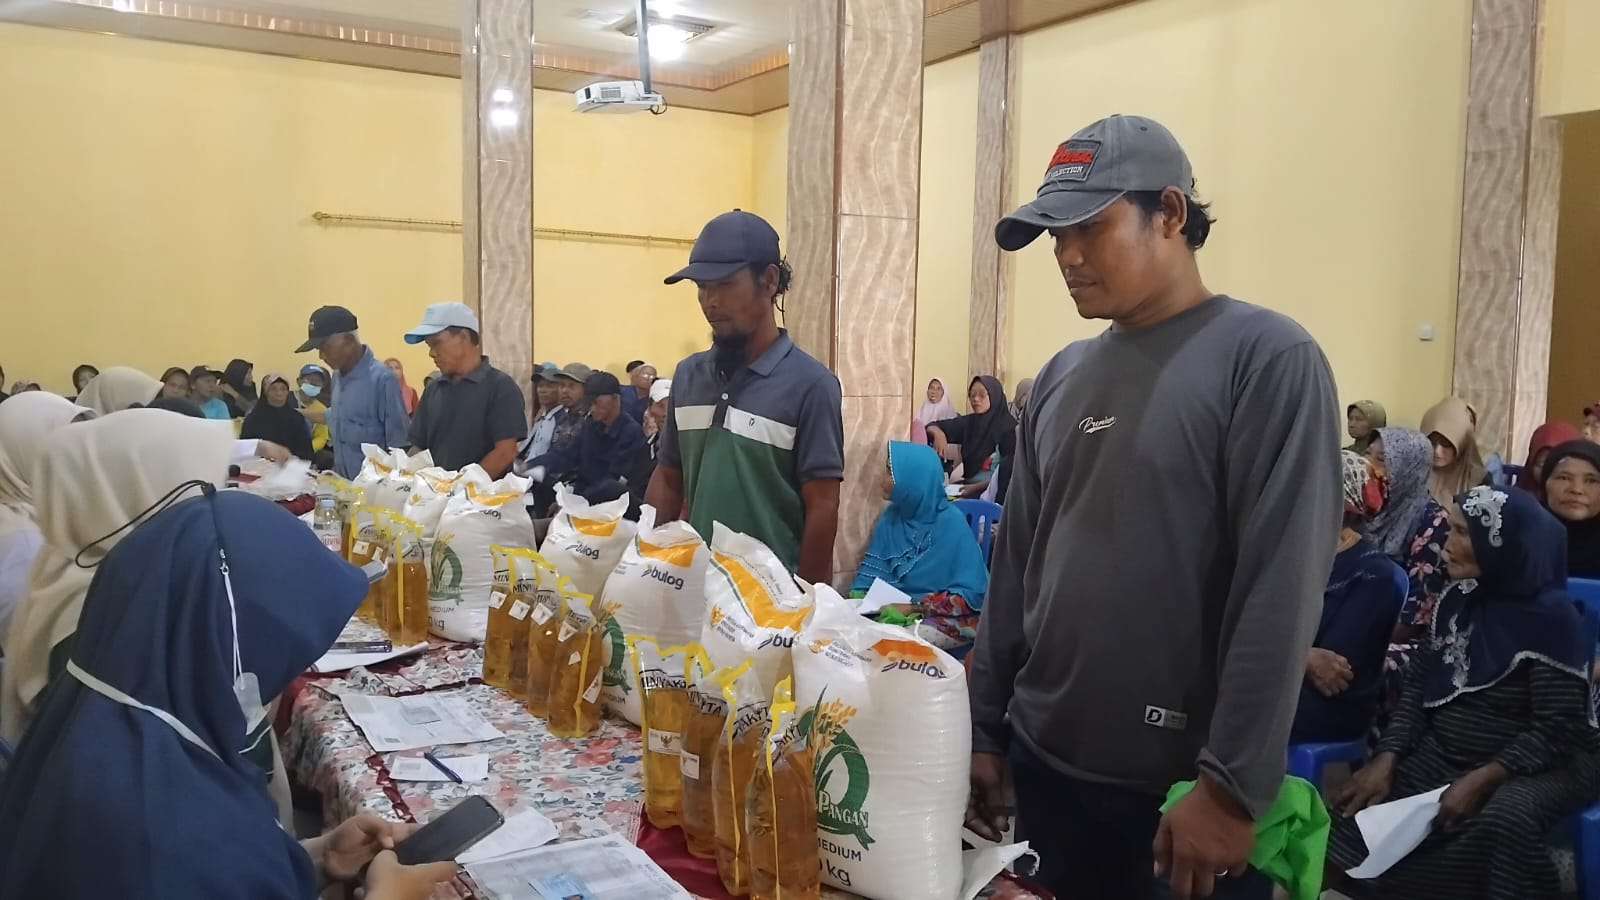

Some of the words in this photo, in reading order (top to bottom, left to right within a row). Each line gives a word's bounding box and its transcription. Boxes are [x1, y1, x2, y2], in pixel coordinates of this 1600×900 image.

[651, 566, 684, 590] bulog
[818, 790, 869, 828] PANGAN
[826, 858, 851, 887] kg
